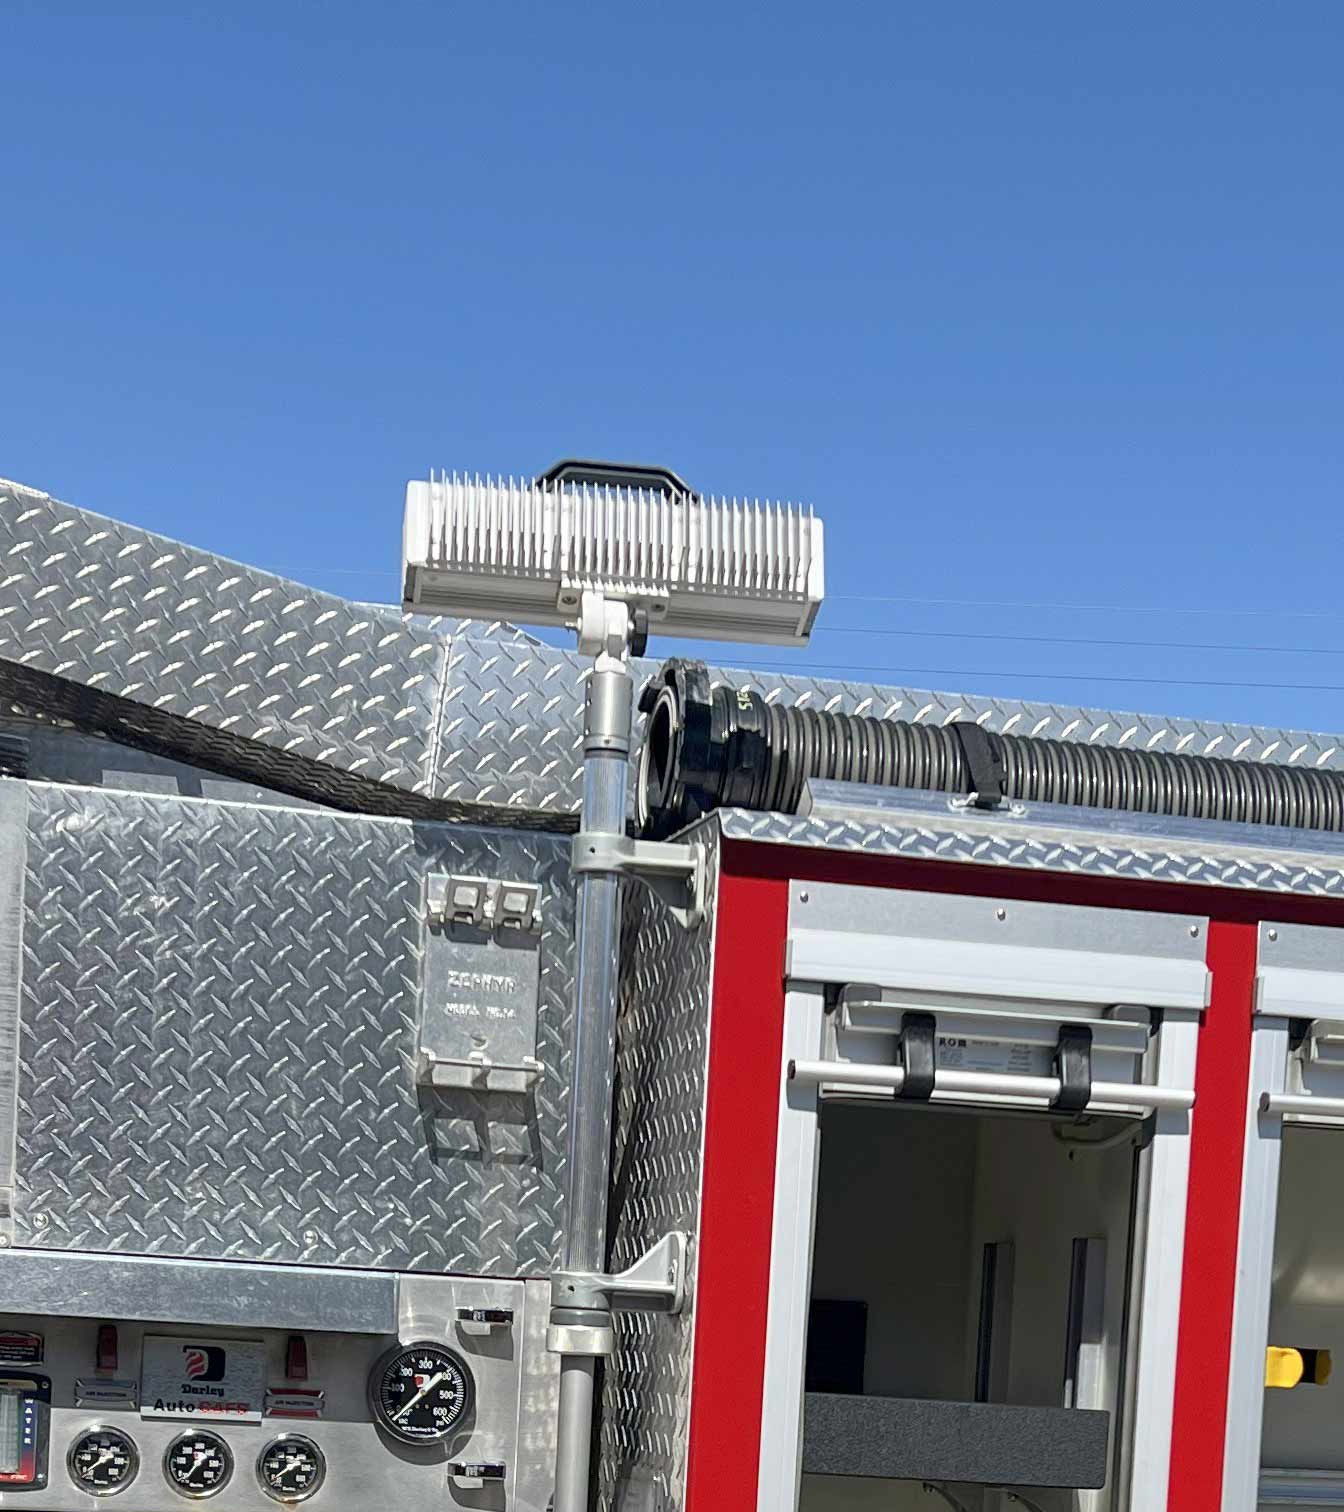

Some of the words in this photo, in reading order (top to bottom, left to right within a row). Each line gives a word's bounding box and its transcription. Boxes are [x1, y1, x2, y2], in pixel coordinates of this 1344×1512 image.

[418, 1360, 433, 1369] 300
[181, 1384, 225, 1396] Darley
[439, 1390, 454, 1399] 500
